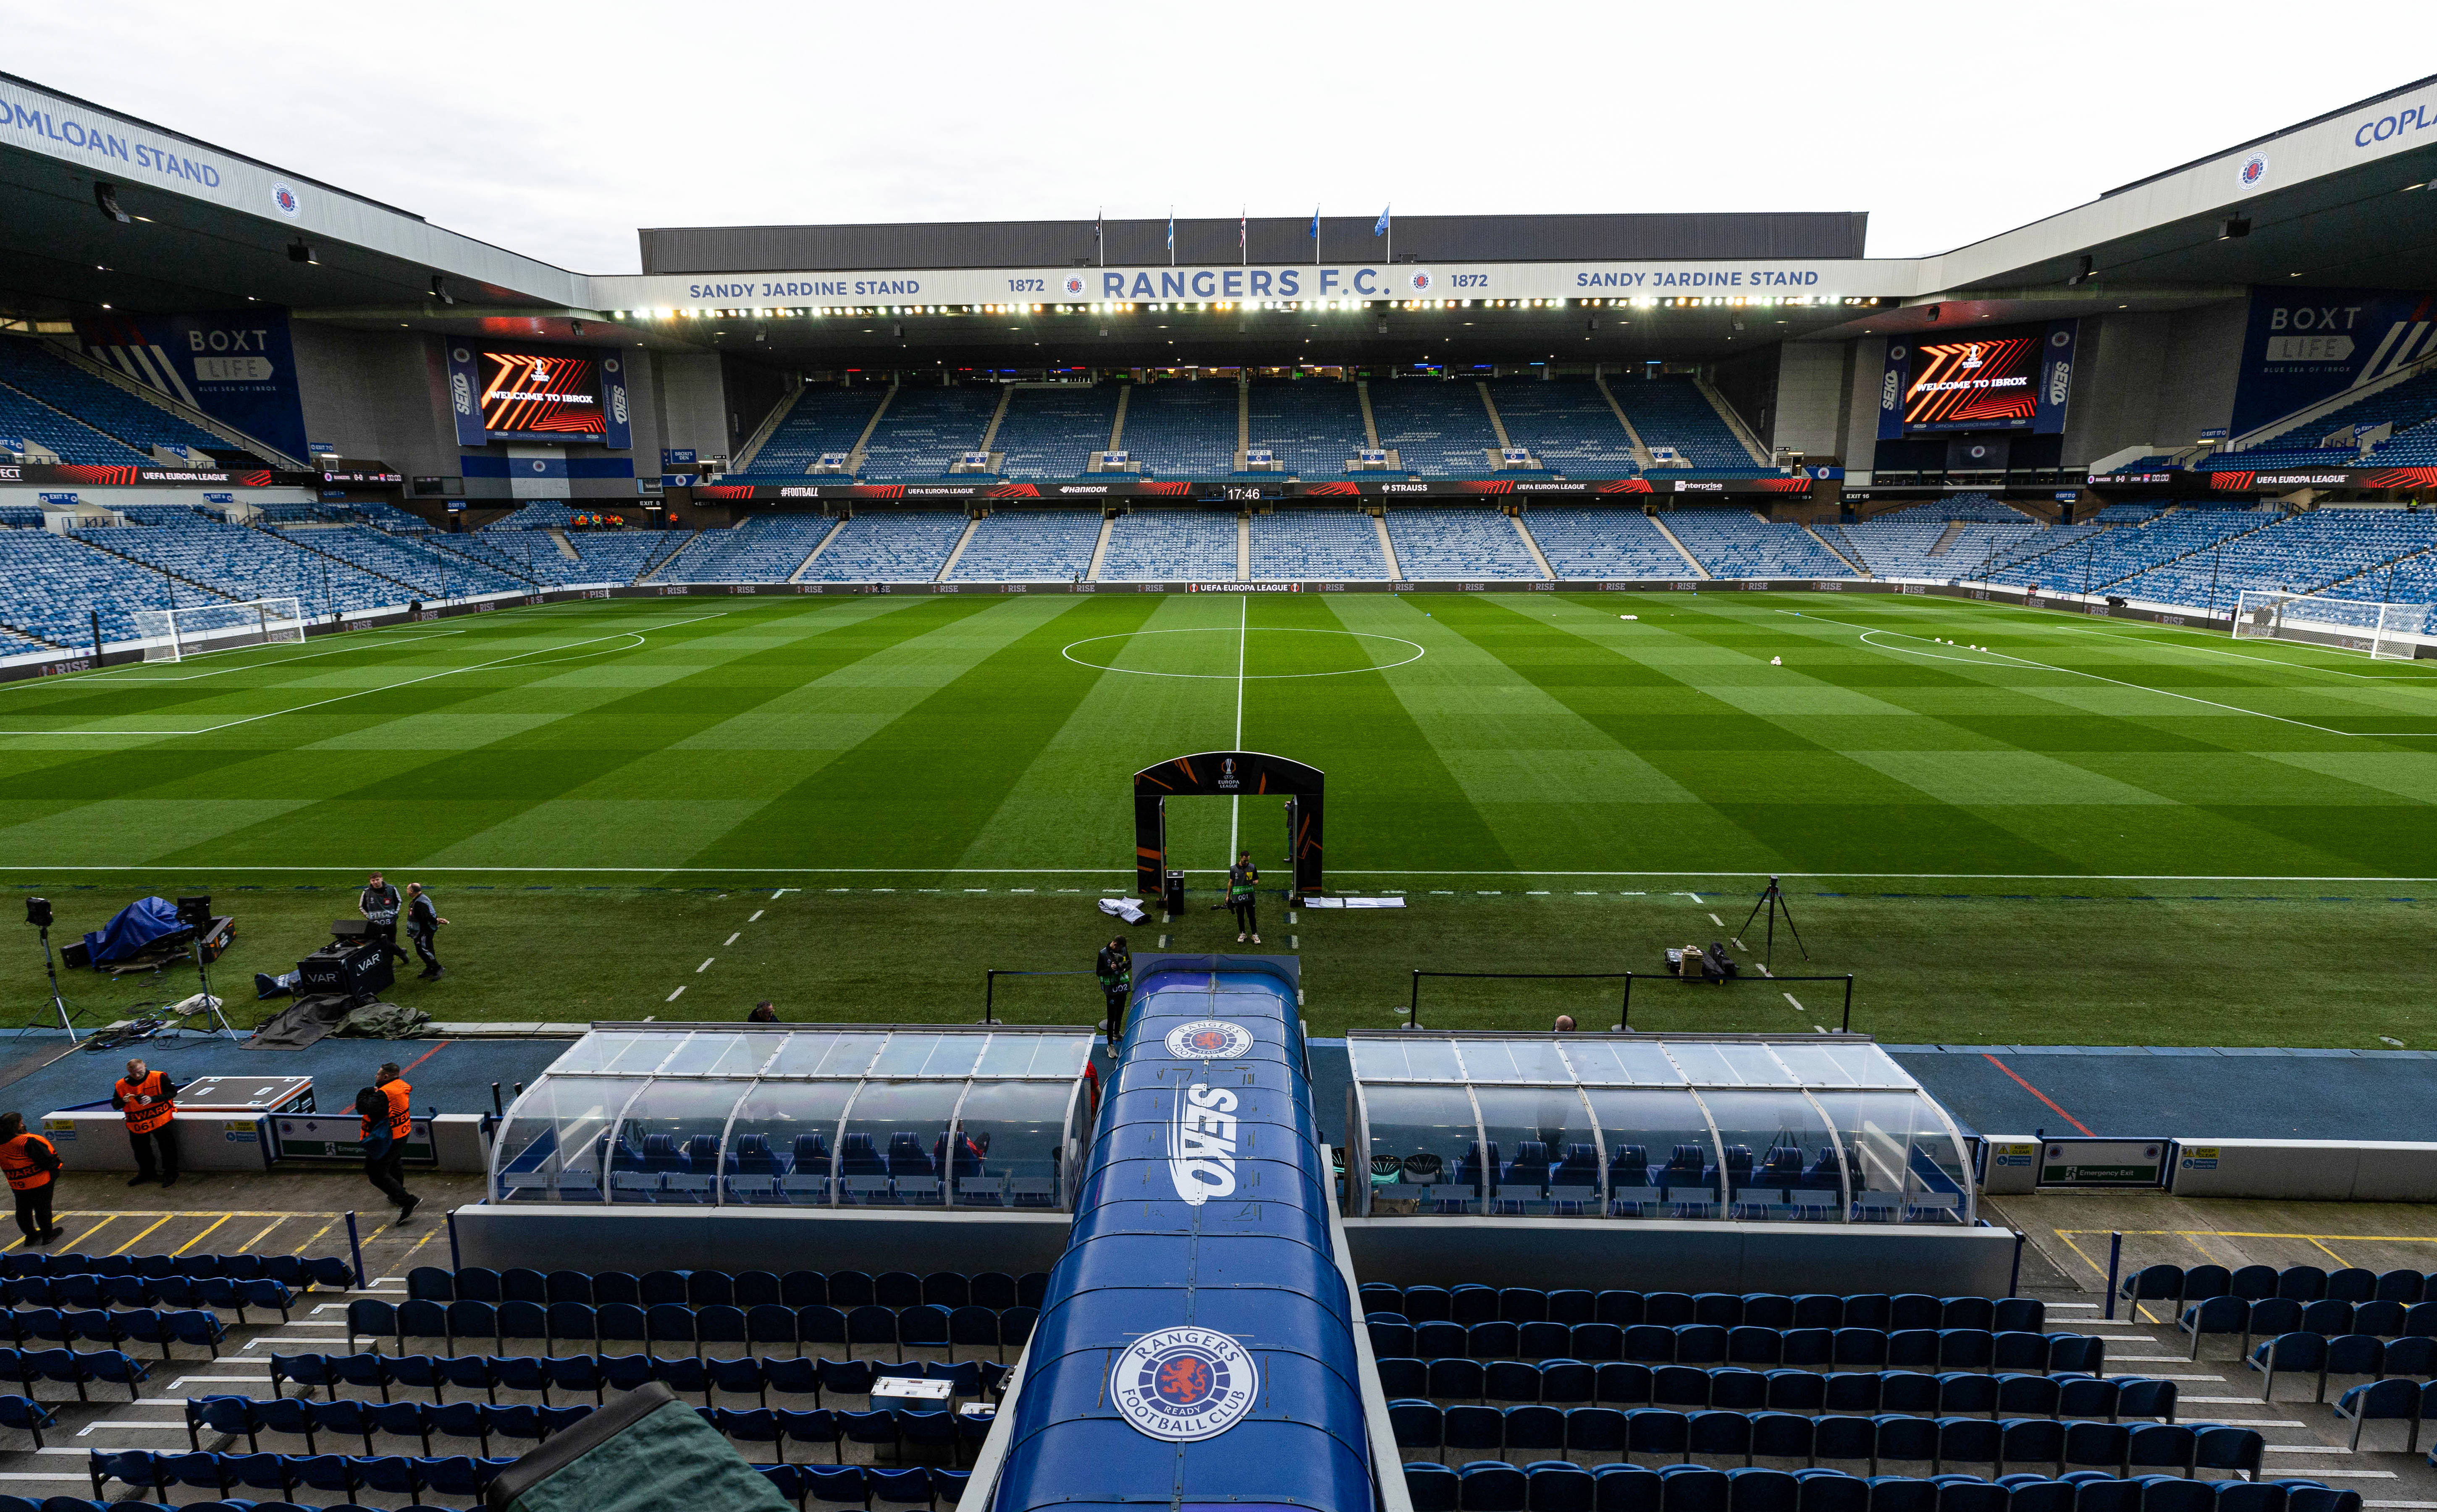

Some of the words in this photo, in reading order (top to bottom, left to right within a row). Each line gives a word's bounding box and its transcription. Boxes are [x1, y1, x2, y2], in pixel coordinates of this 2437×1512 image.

[136, 144, 219, 187] STAND
[2243, 153, 2267, 167] RANGERS
[1008, 279, 1044, 292] 1872
[1104, 270, 1299, 298] RANGERS
[1320, 269, 1390, 295] F.C.
[1451, 274, 1488, 287] 1872
[1577, 273, 1645, 286] SANDY
[1653, 272, 1742, 286] JARDINE
[1750, 271, 1818, 286] STAND
[690, 284, 755, 298] SANDY
[763, 282, 847, 297] JARDINE
[855, 280, 920, 295] STAND
[2271, 307, 2361, 330] BOXT
[189, 330, 267, 351] BOXT
[2282, 339, 2337, 358] LIFE
[209, 360, 258, 377] LIFE
[1882, 369, 1898, 410] SEKO
[1916, 380, 1971, 391] WELCOME
[1973, 379, 1989, 388] TO
[1991, 377, 2028, 387] IBROX
[2051, 361, 2070, 406] SEKO
[453, 372, 470, 415] SEKO
[490, 391, 544, 401] WELCOME
[562, 394, 593, 403] IBROX
[613, 385, 627, 424] SEKO
[0, 469, 20, 478] ECT
[165, 472, 198, 480] EUROPA
[781, 487, 818, 497] #FOOTBALL
[1228, 488, 1260, 500] 17:46
[1905, 585, 1924, 594] RISE
[479, 603, 494, 611] RISE
[2028, 598, 2045, 608] RISE
[2091, 607, 2109, 616] RISE
[352, 620, 373, 629] RISE
[2163, 614, 2184, 626] RISE
[273, 630, 296, 642] RISE
[55, 660, 90, 675] RISE
[358, 953, 380, 971] VAR
[307, 974, 337, 983] VAR
[1178, 1022, 1242, 1034] RANGERS
[1225, 1043, 1246, 1057] CLUB
[134, 1120, 155, 1132] 061
[1181, 1083, 1238, 1205] SEKO
[1135, 1332, 1241, 1362] RANGERS
[1122, 1389, 1208, 1432] FOOTBALL
[1164, 1405, 1201, 1415] READY
[1209, 1390, 1245, 1423] CLUB
